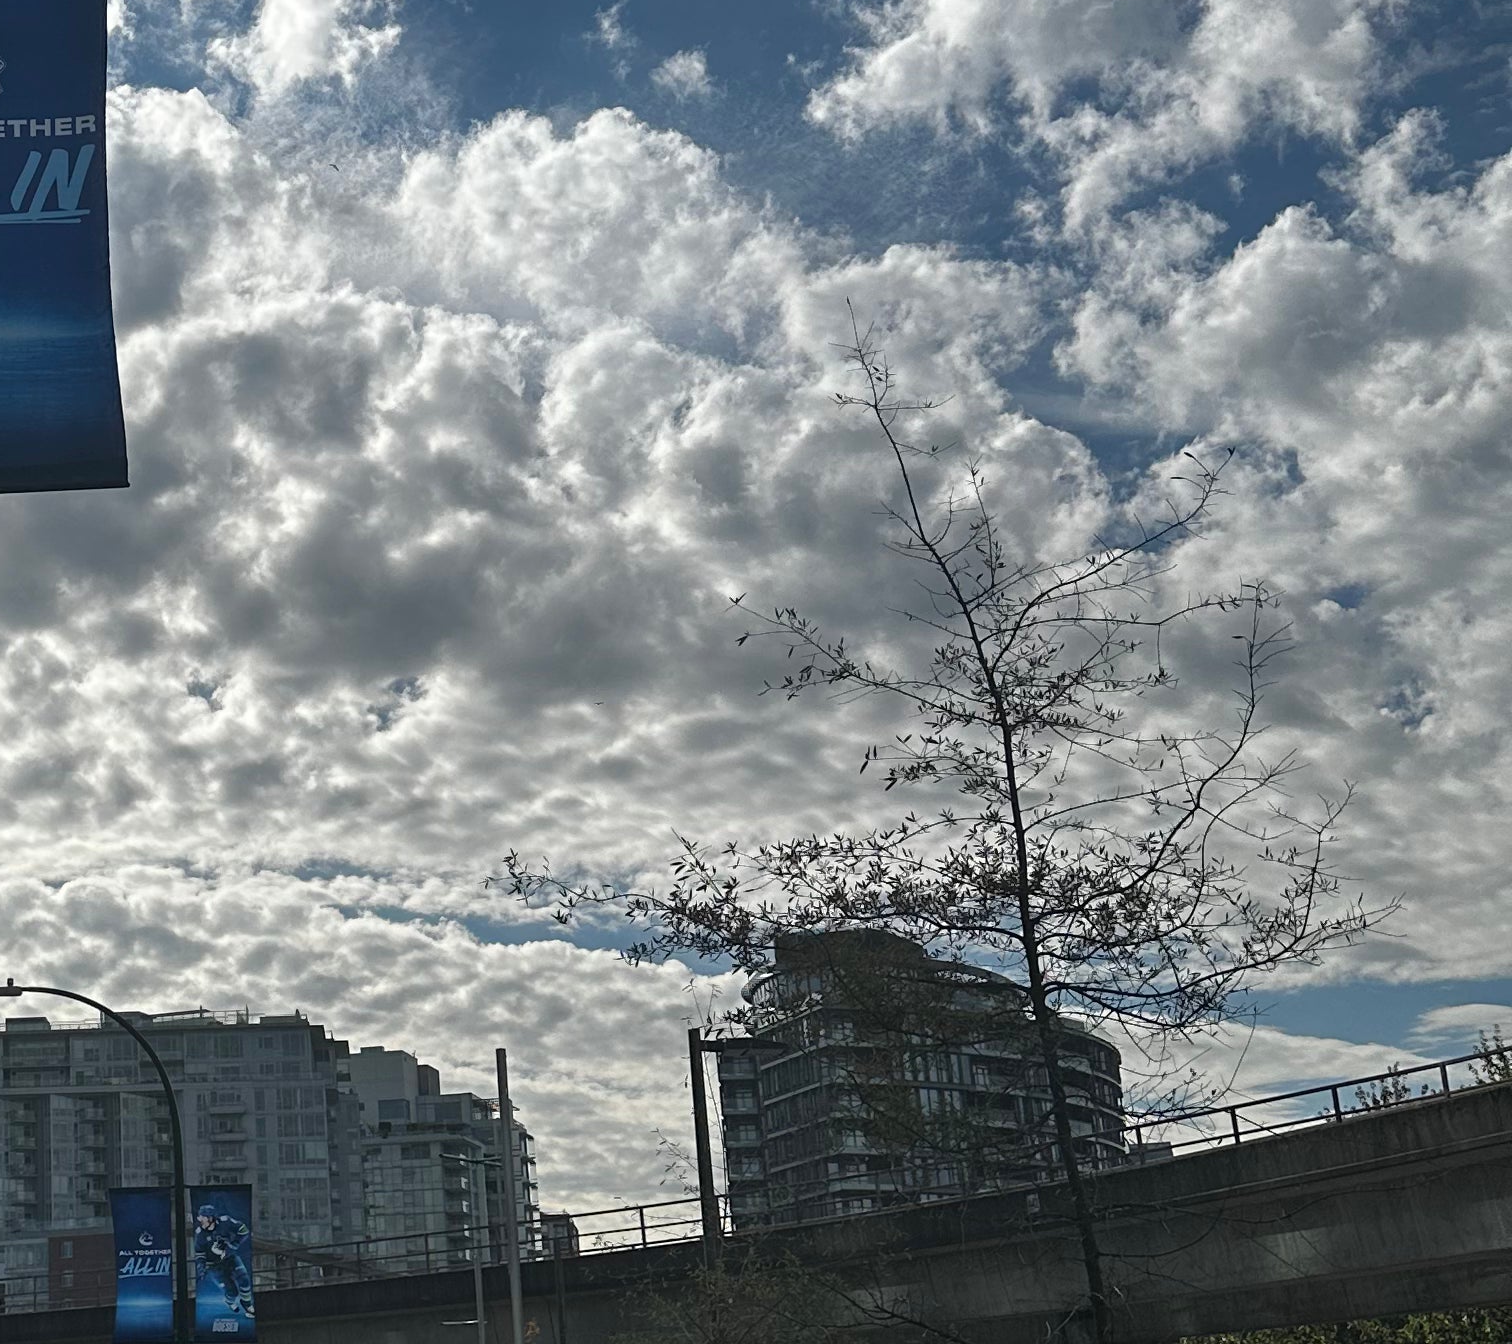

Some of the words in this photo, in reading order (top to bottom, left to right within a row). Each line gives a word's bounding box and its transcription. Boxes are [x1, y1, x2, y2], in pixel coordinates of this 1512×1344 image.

[9, 143, 97, 221] IN
[118, 1249, 133, 1257] ALL
[134, 1248, 172, 1256] TOGETHER
[119, 1256, 154, 1276] ALL
[155, 1256, 172, 1275] IN
